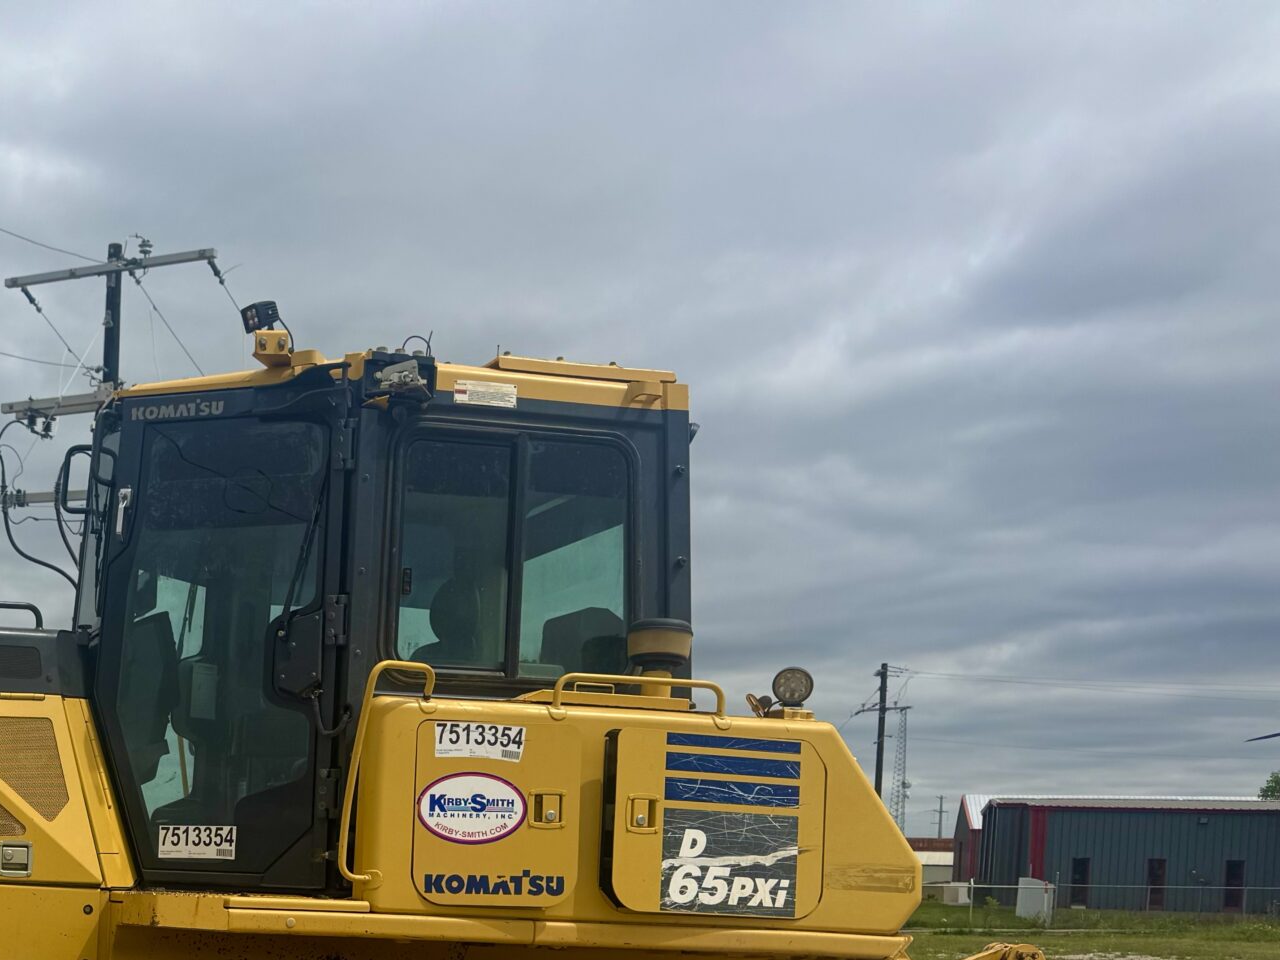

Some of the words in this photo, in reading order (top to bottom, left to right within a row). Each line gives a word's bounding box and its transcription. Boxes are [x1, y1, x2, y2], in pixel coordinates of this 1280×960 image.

[131, 399, 225, 421] KOMATSU
[436, 723, 524, 750] 7513354
[160, 826, 234, 848] 7513354
[434, 821, 509, 839] KIRBY-SMITH.COM
[678, 828, 707, 858] D
[424, 869, 565, 897] KOMATSU
